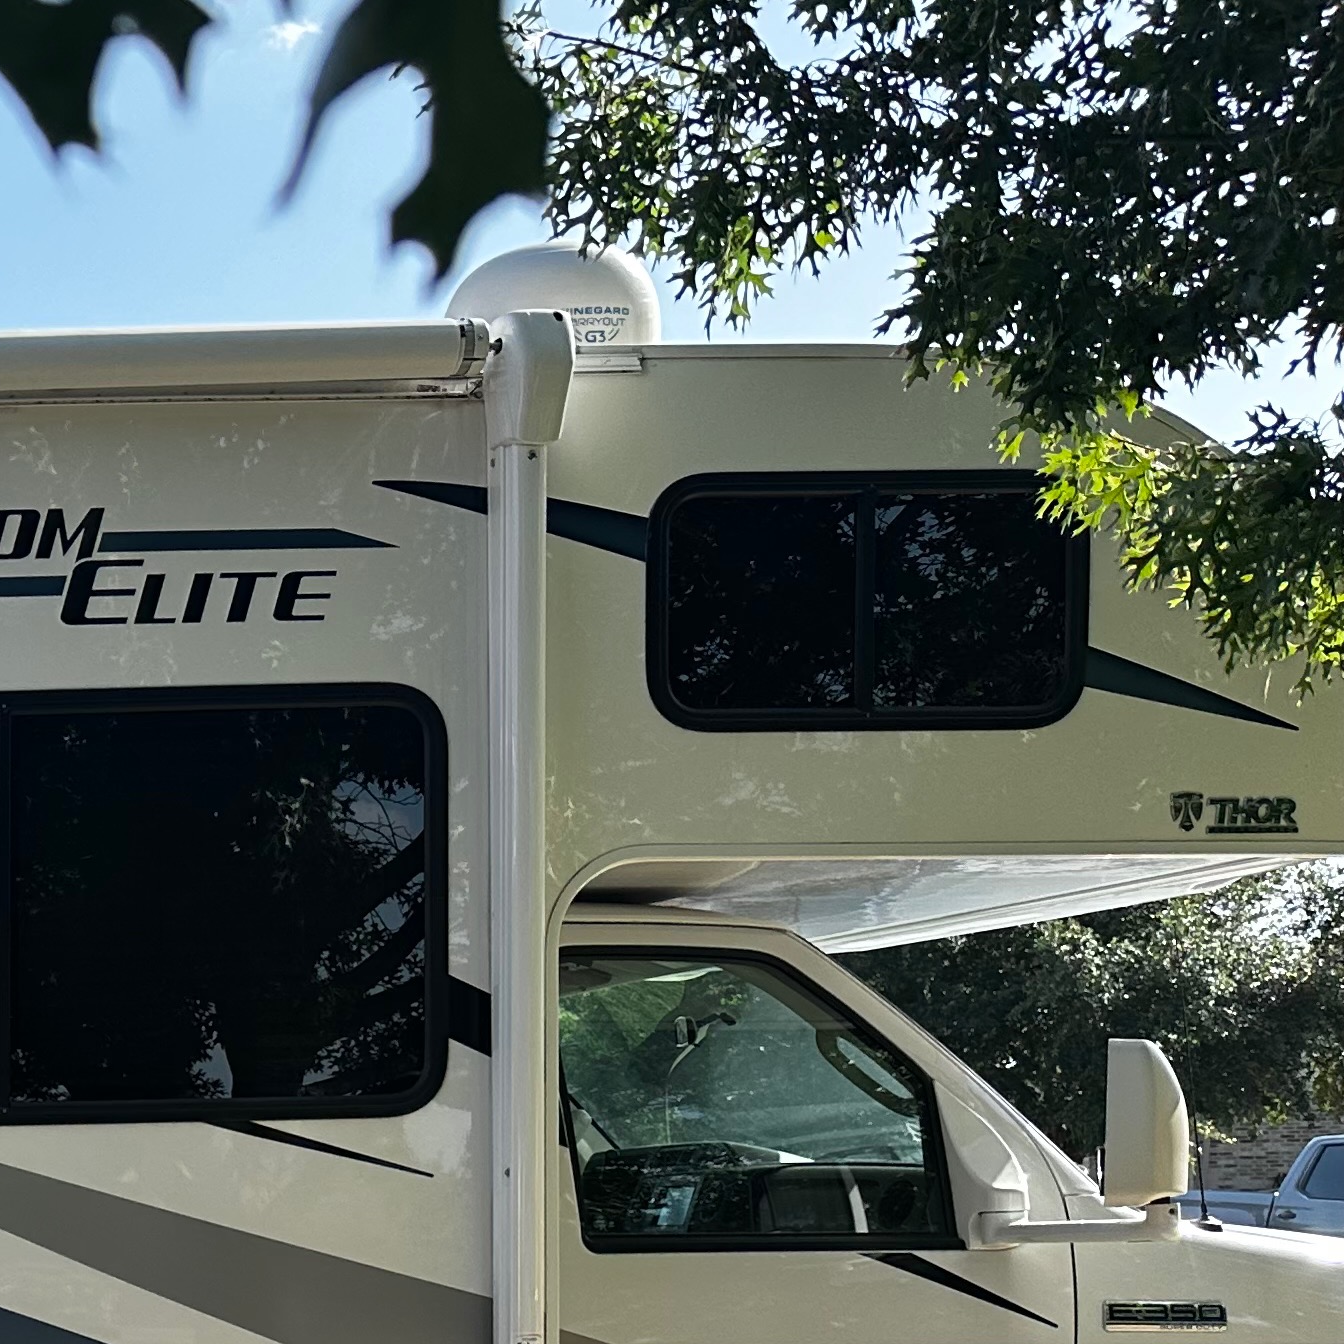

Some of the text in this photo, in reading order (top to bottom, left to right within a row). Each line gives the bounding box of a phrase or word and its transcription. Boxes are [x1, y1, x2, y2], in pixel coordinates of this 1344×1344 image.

[572, 317, 626, 327] ARRYOUT
[585, 330, 606, 342] G3
[60, 558, 338, 626] ELITE
[1206, 797, 1298, 826] THOR
